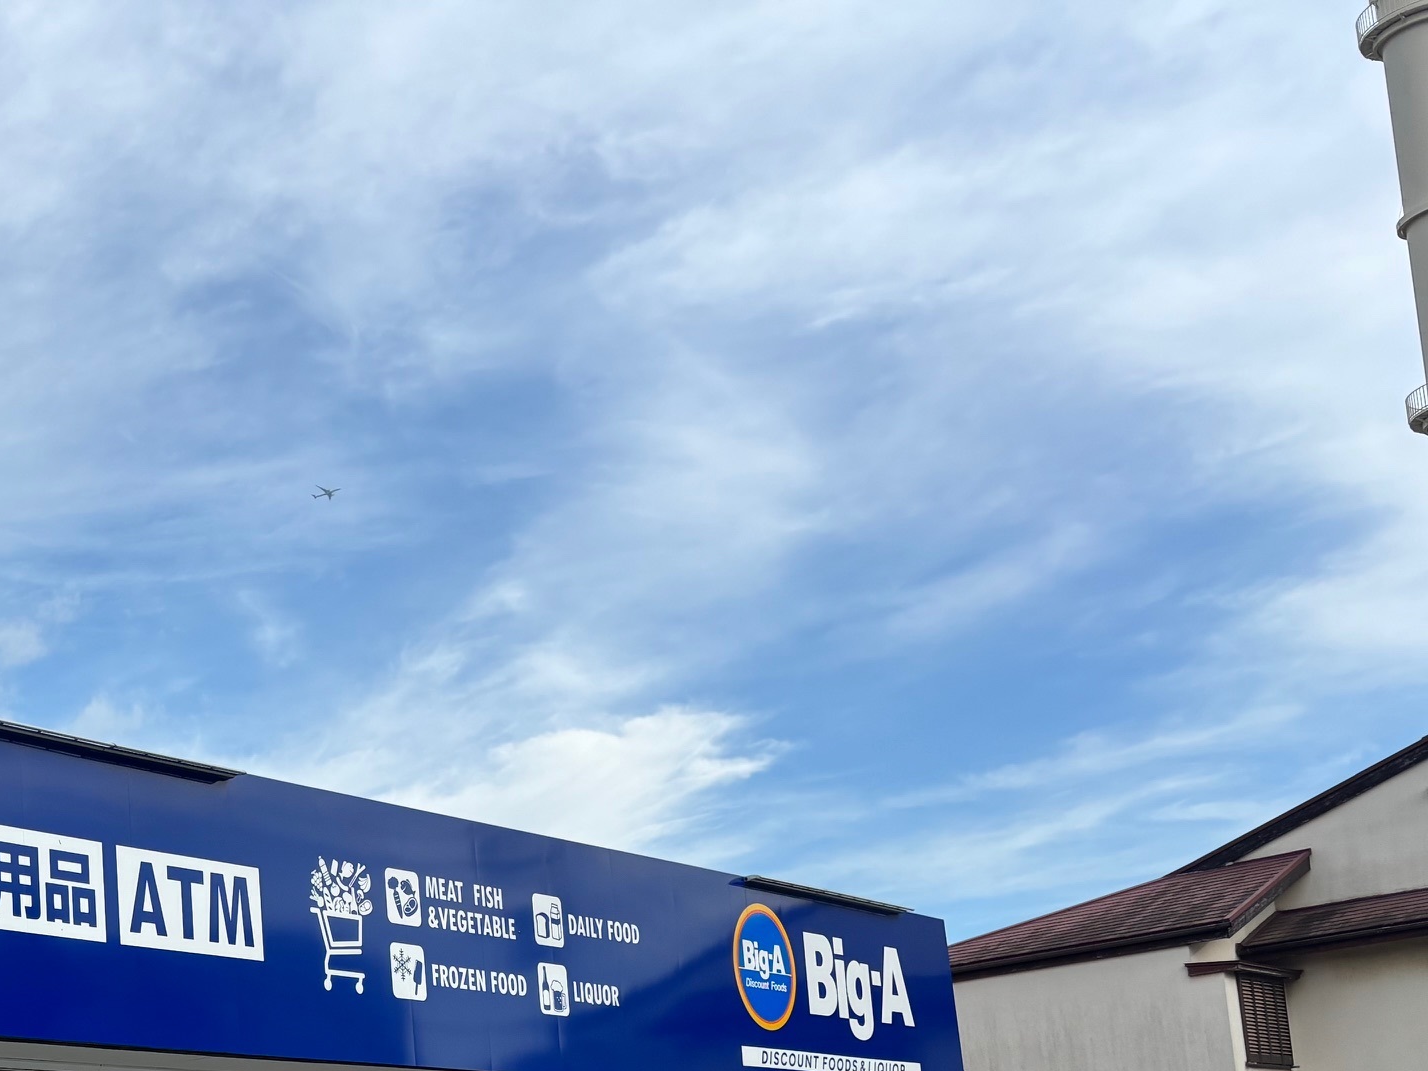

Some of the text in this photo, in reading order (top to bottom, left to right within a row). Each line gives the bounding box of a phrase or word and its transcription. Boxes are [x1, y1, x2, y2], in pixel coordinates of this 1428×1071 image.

[131, 861, 254, 948] ATM
[425, 875, 504, 910] MEAT FISH
[428, 906, 517, 940] &VEGETABLE
[567, 913, 640, 945] DAILY FOOD
[742, 939, 786, 980] Big-A
[431, 963, 527, 997] FROZEN FOOD
[573, 980, 620, 1007] LIQUOR
[745, 977, 787, 993] Discount Foods
[802, 931, 916, 1041] Big-A
[761, 1050, 819, 1070] DISCOUNT
